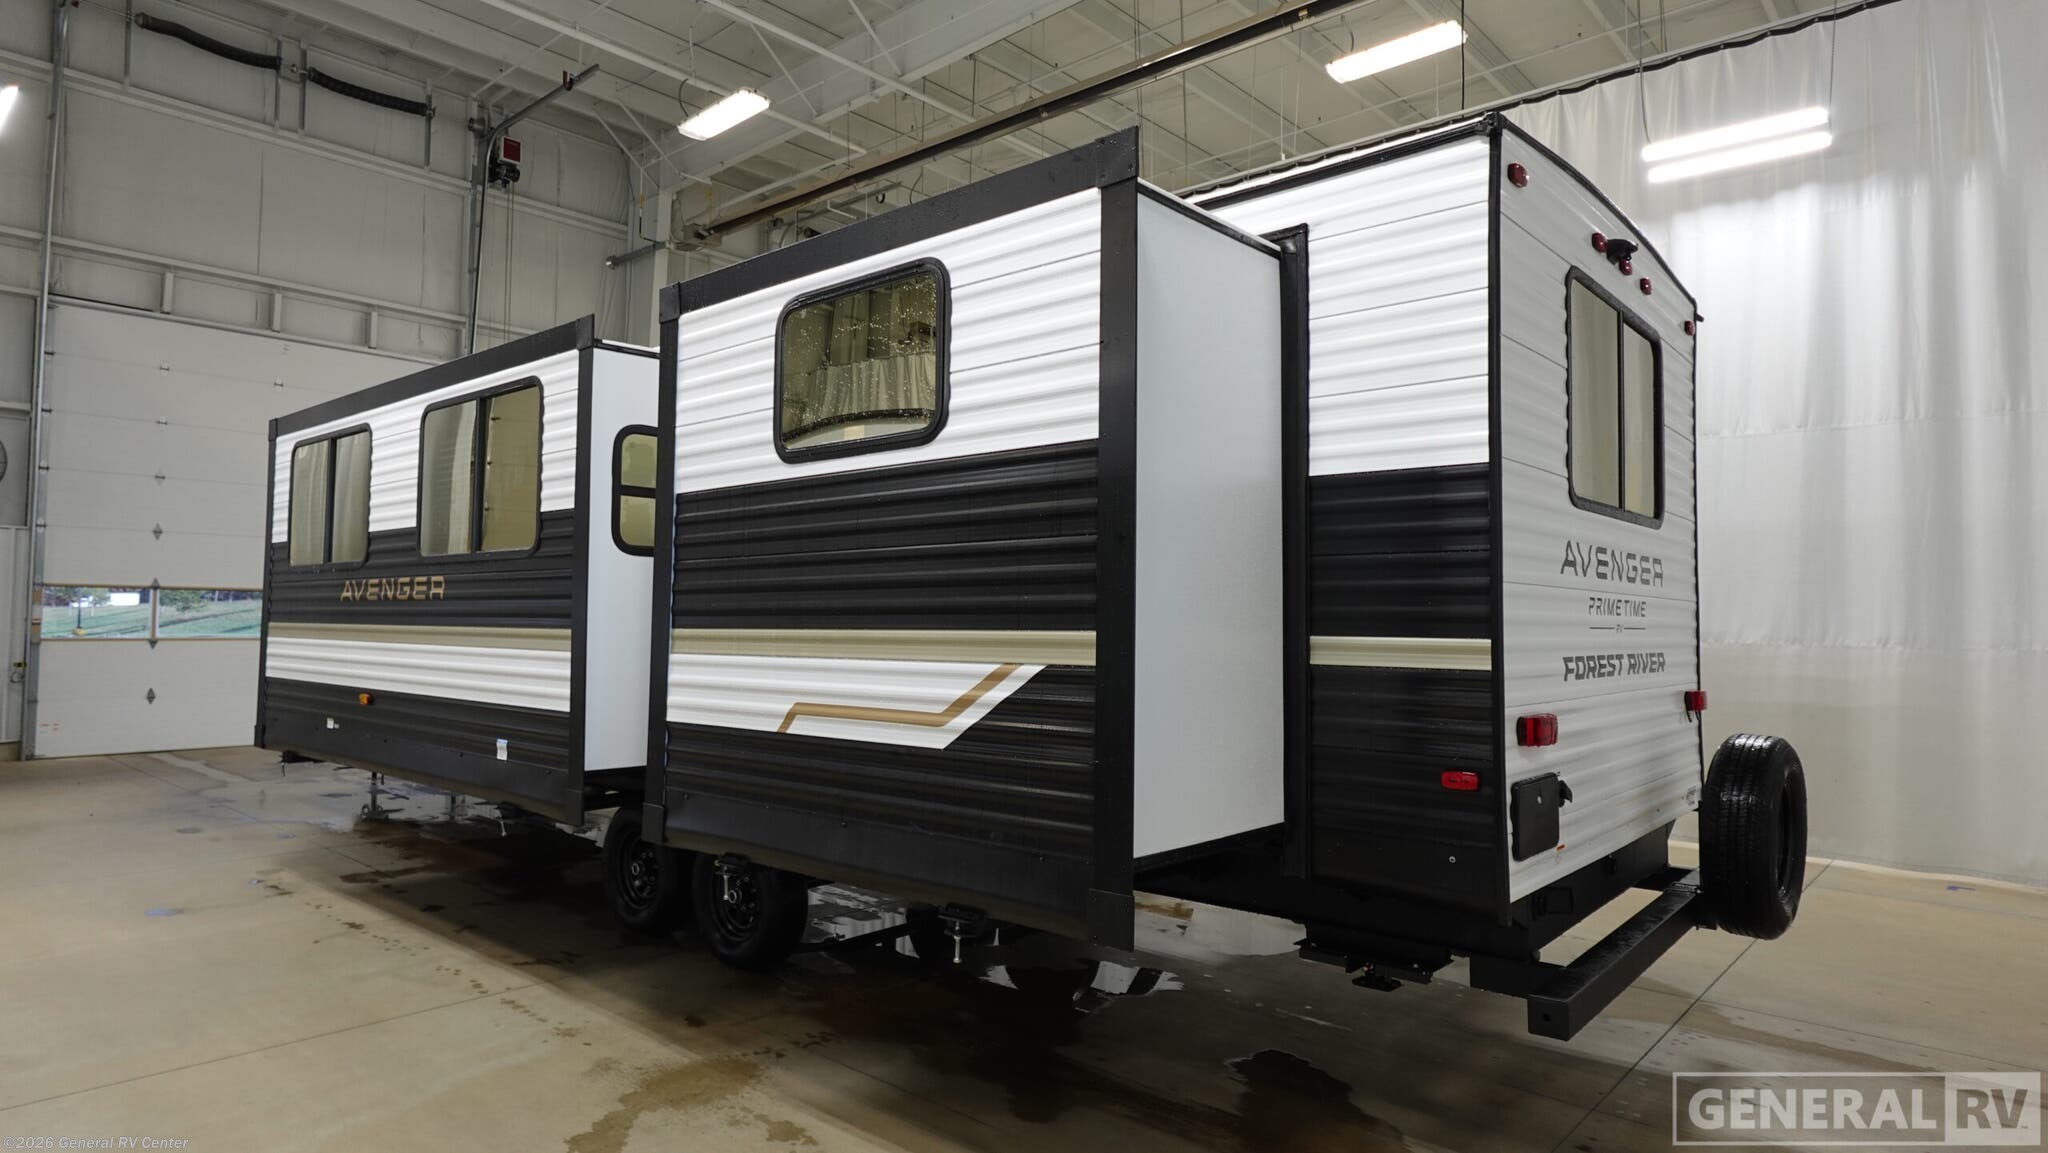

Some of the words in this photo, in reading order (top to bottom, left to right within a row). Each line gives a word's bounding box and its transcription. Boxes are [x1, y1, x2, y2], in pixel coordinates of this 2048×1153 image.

[1560, 540, 1664, 588] AVENGER
[340, 575, 446, 602] AVENGER
[1562, 653, 1624, 682] FOREST
[1626, 652, 1666, 676] RIVER
